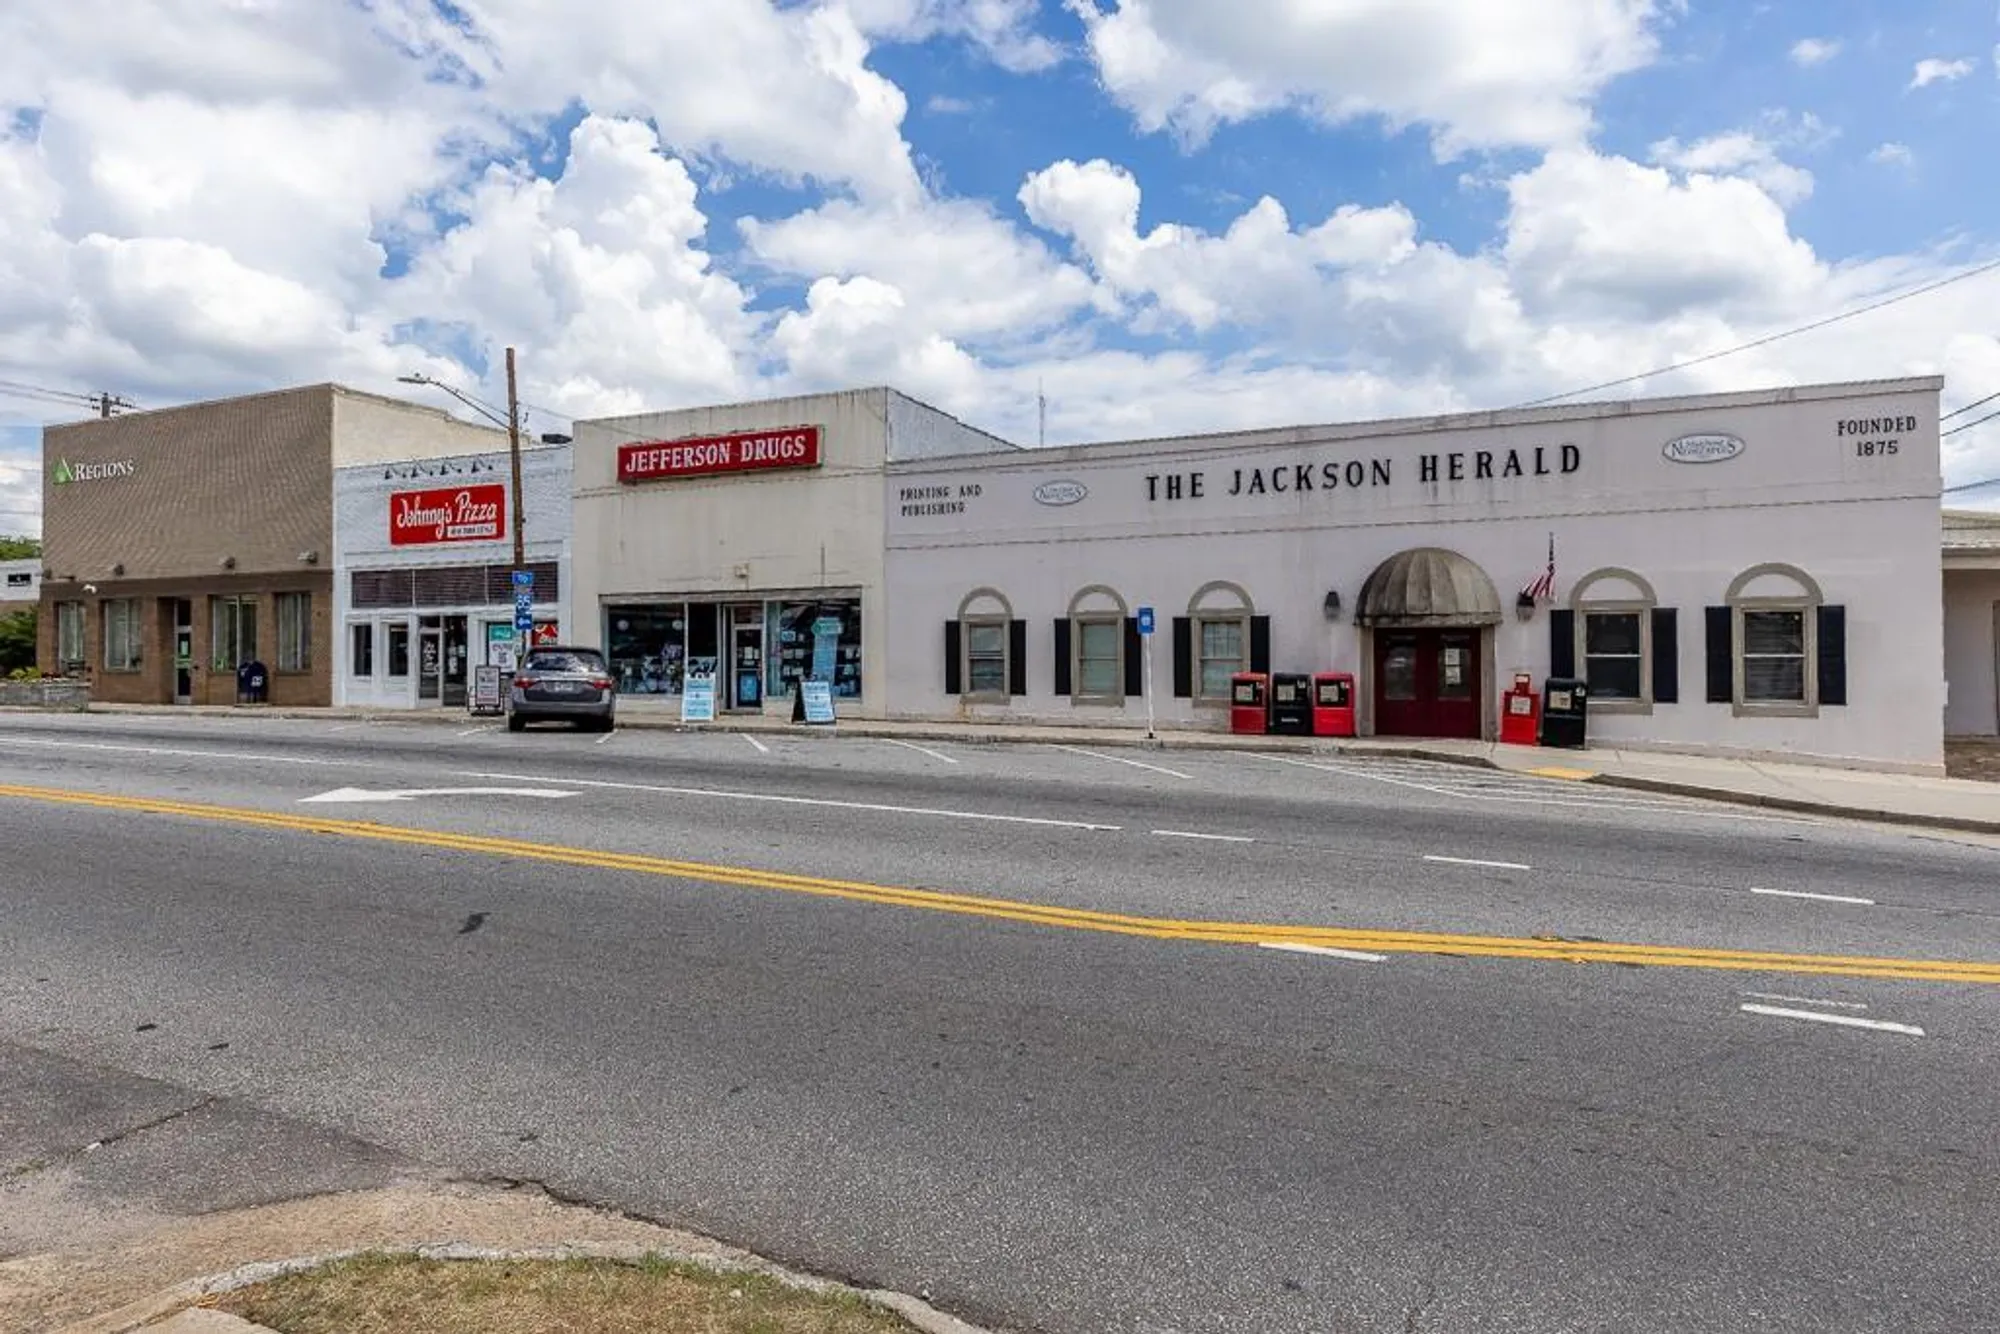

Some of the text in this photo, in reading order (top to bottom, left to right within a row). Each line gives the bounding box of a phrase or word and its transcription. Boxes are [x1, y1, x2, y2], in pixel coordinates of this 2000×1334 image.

[1837, 415, 1916, 436] FOUNDED
[625, 434, 807, 472] JEFFERSON DRUGS
[1856, 440, 1898, 456] 1875
[75, 459, 134, 481] REGIONS
[1146, 444, 1581, 501] THE JACKSON HERALD
[900, 483, 983, 501] PRINTING AND
[396, 491, 497, 540] Johnny's Pizza
